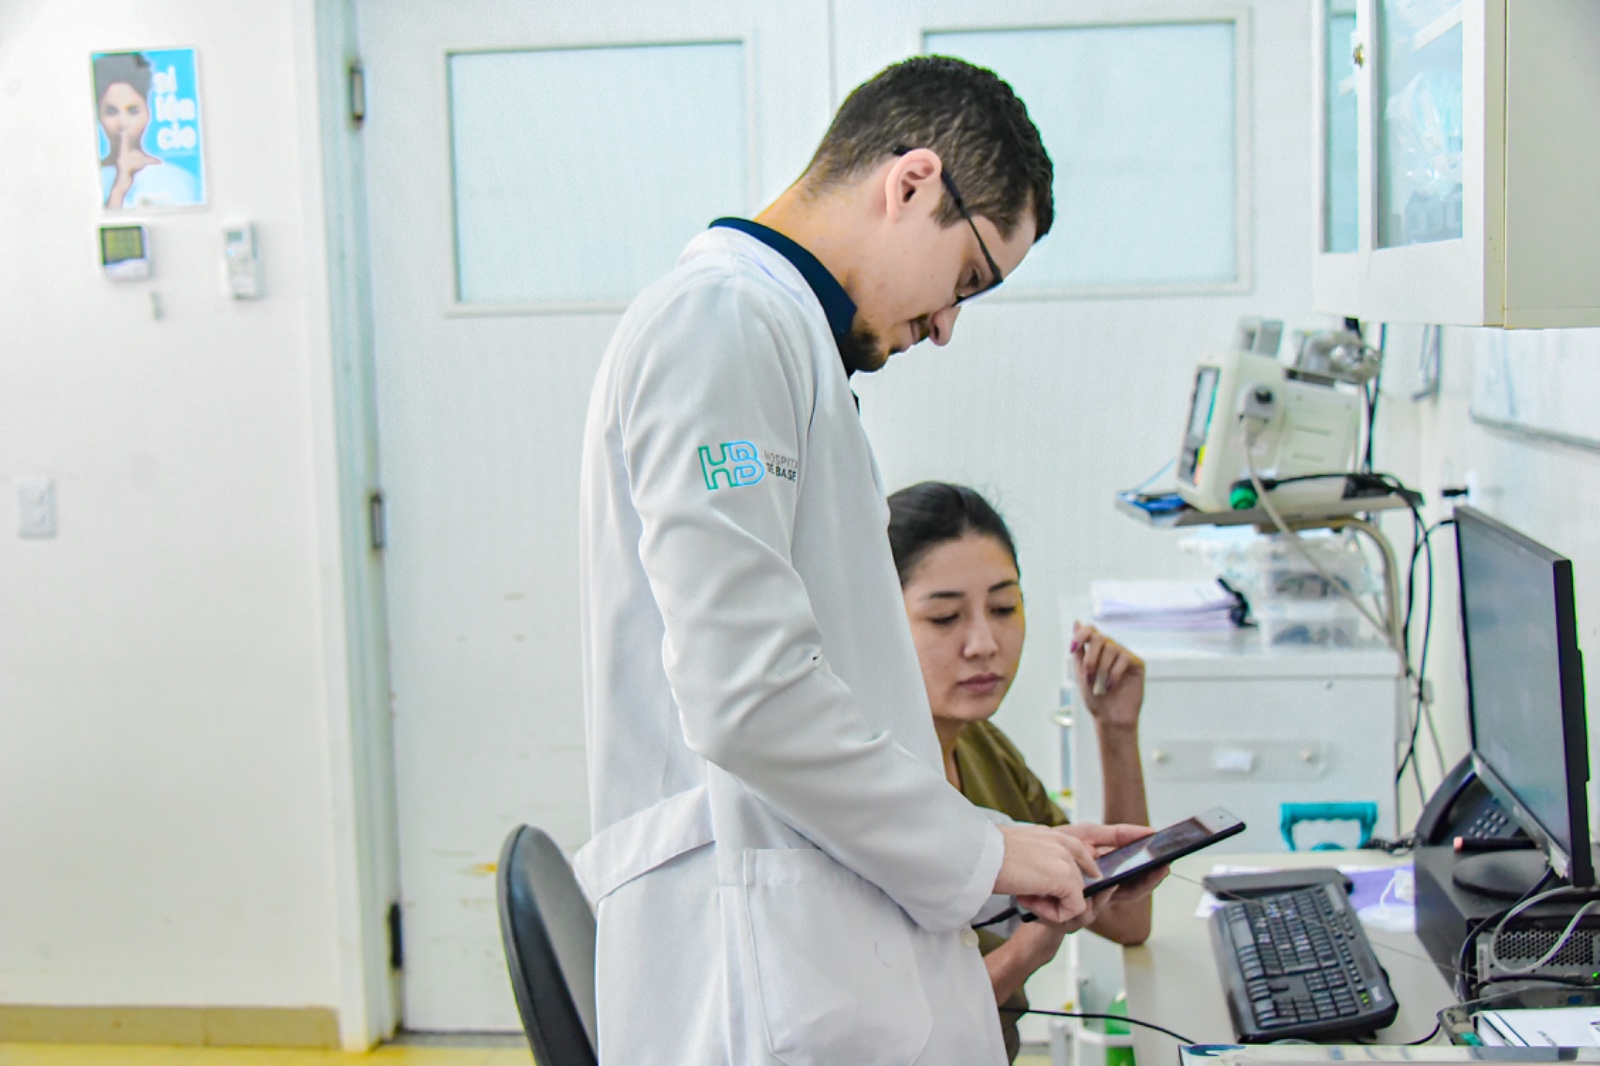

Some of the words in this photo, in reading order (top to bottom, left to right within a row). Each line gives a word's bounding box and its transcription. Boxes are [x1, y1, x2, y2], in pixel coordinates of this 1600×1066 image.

[698, 440, 765, 490] HB
[766, 461, 774, 475] DE
[776, 465, 797, 482] BASE
